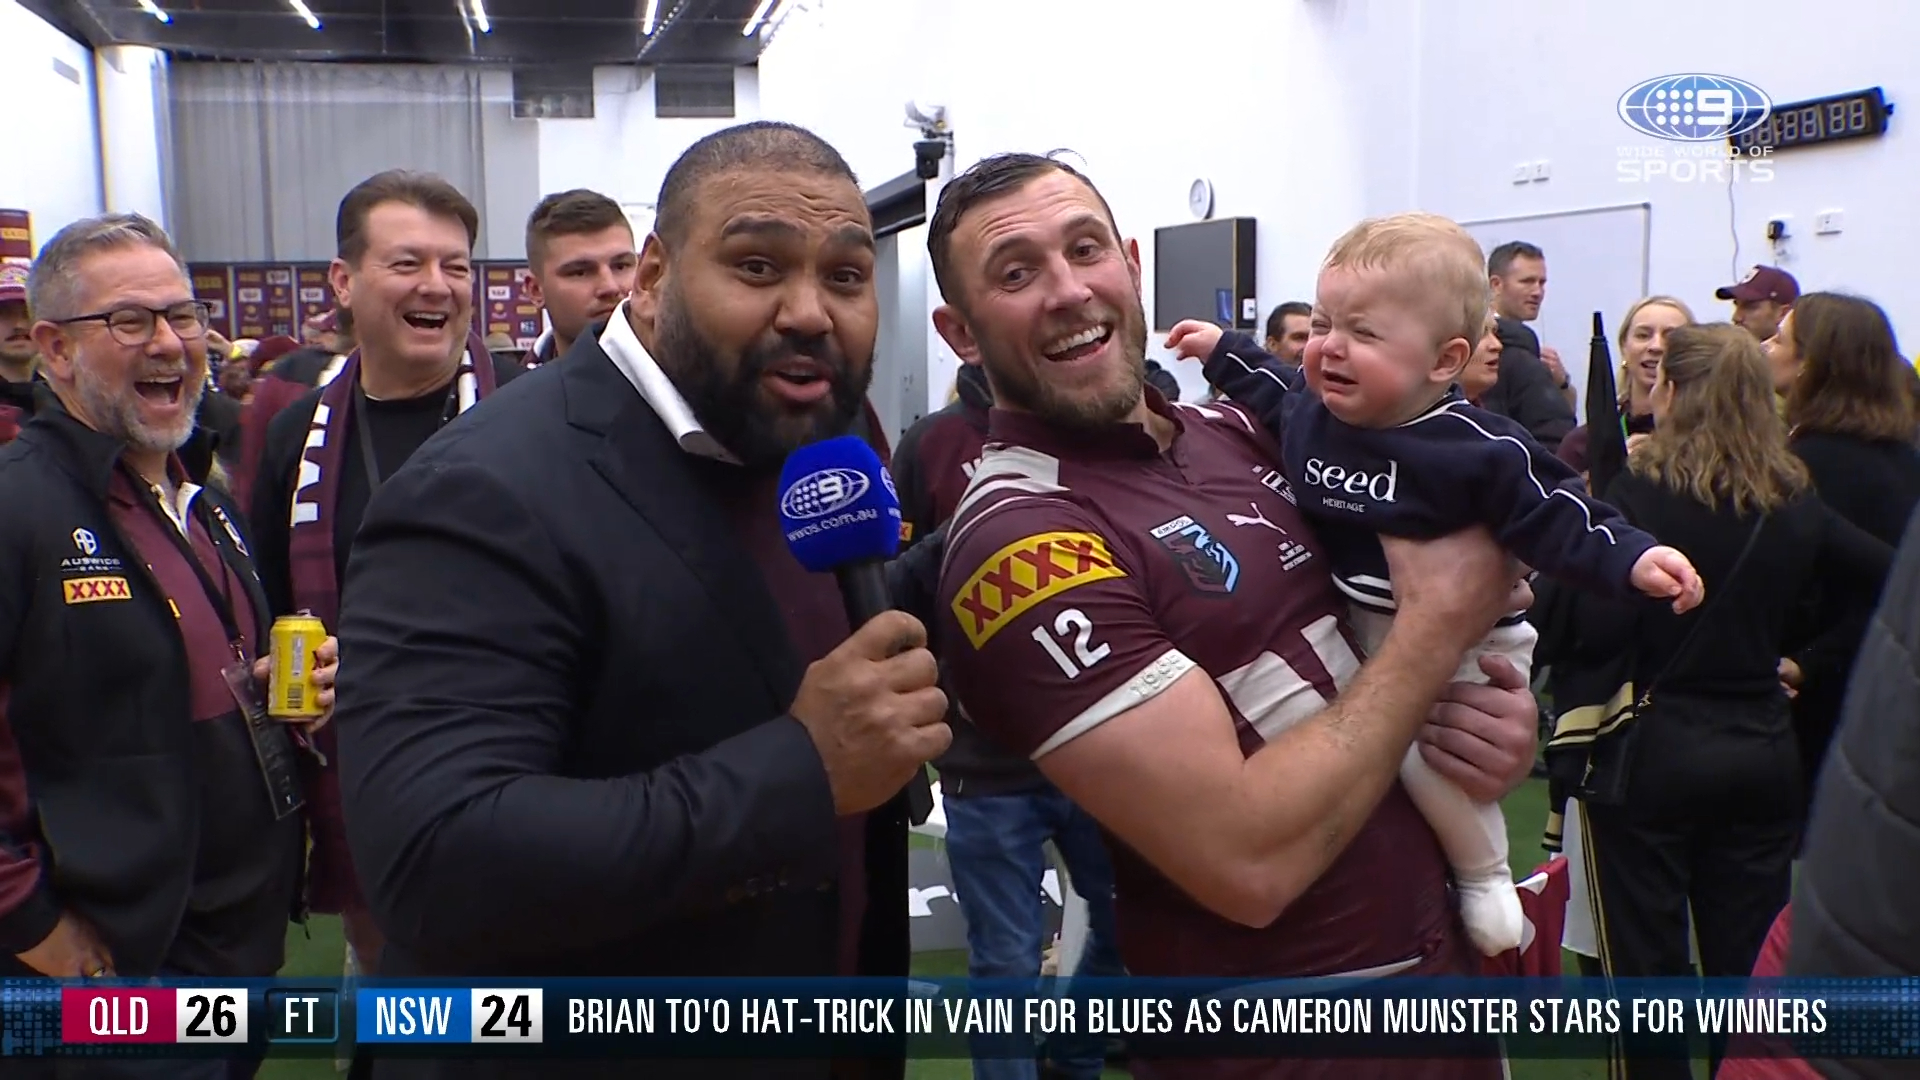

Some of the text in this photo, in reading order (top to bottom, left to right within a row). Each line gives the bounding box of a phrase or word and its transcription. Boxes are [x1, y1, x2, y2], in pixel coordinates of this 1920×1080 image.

[818, 476, 845, 503] 9
[1304, 458, 1398, 503] seed
[70, 580, 128, 600] XXXX
[959, 539, 1113, 636] XXXX
[1031, 608, 1112, 680] 12
